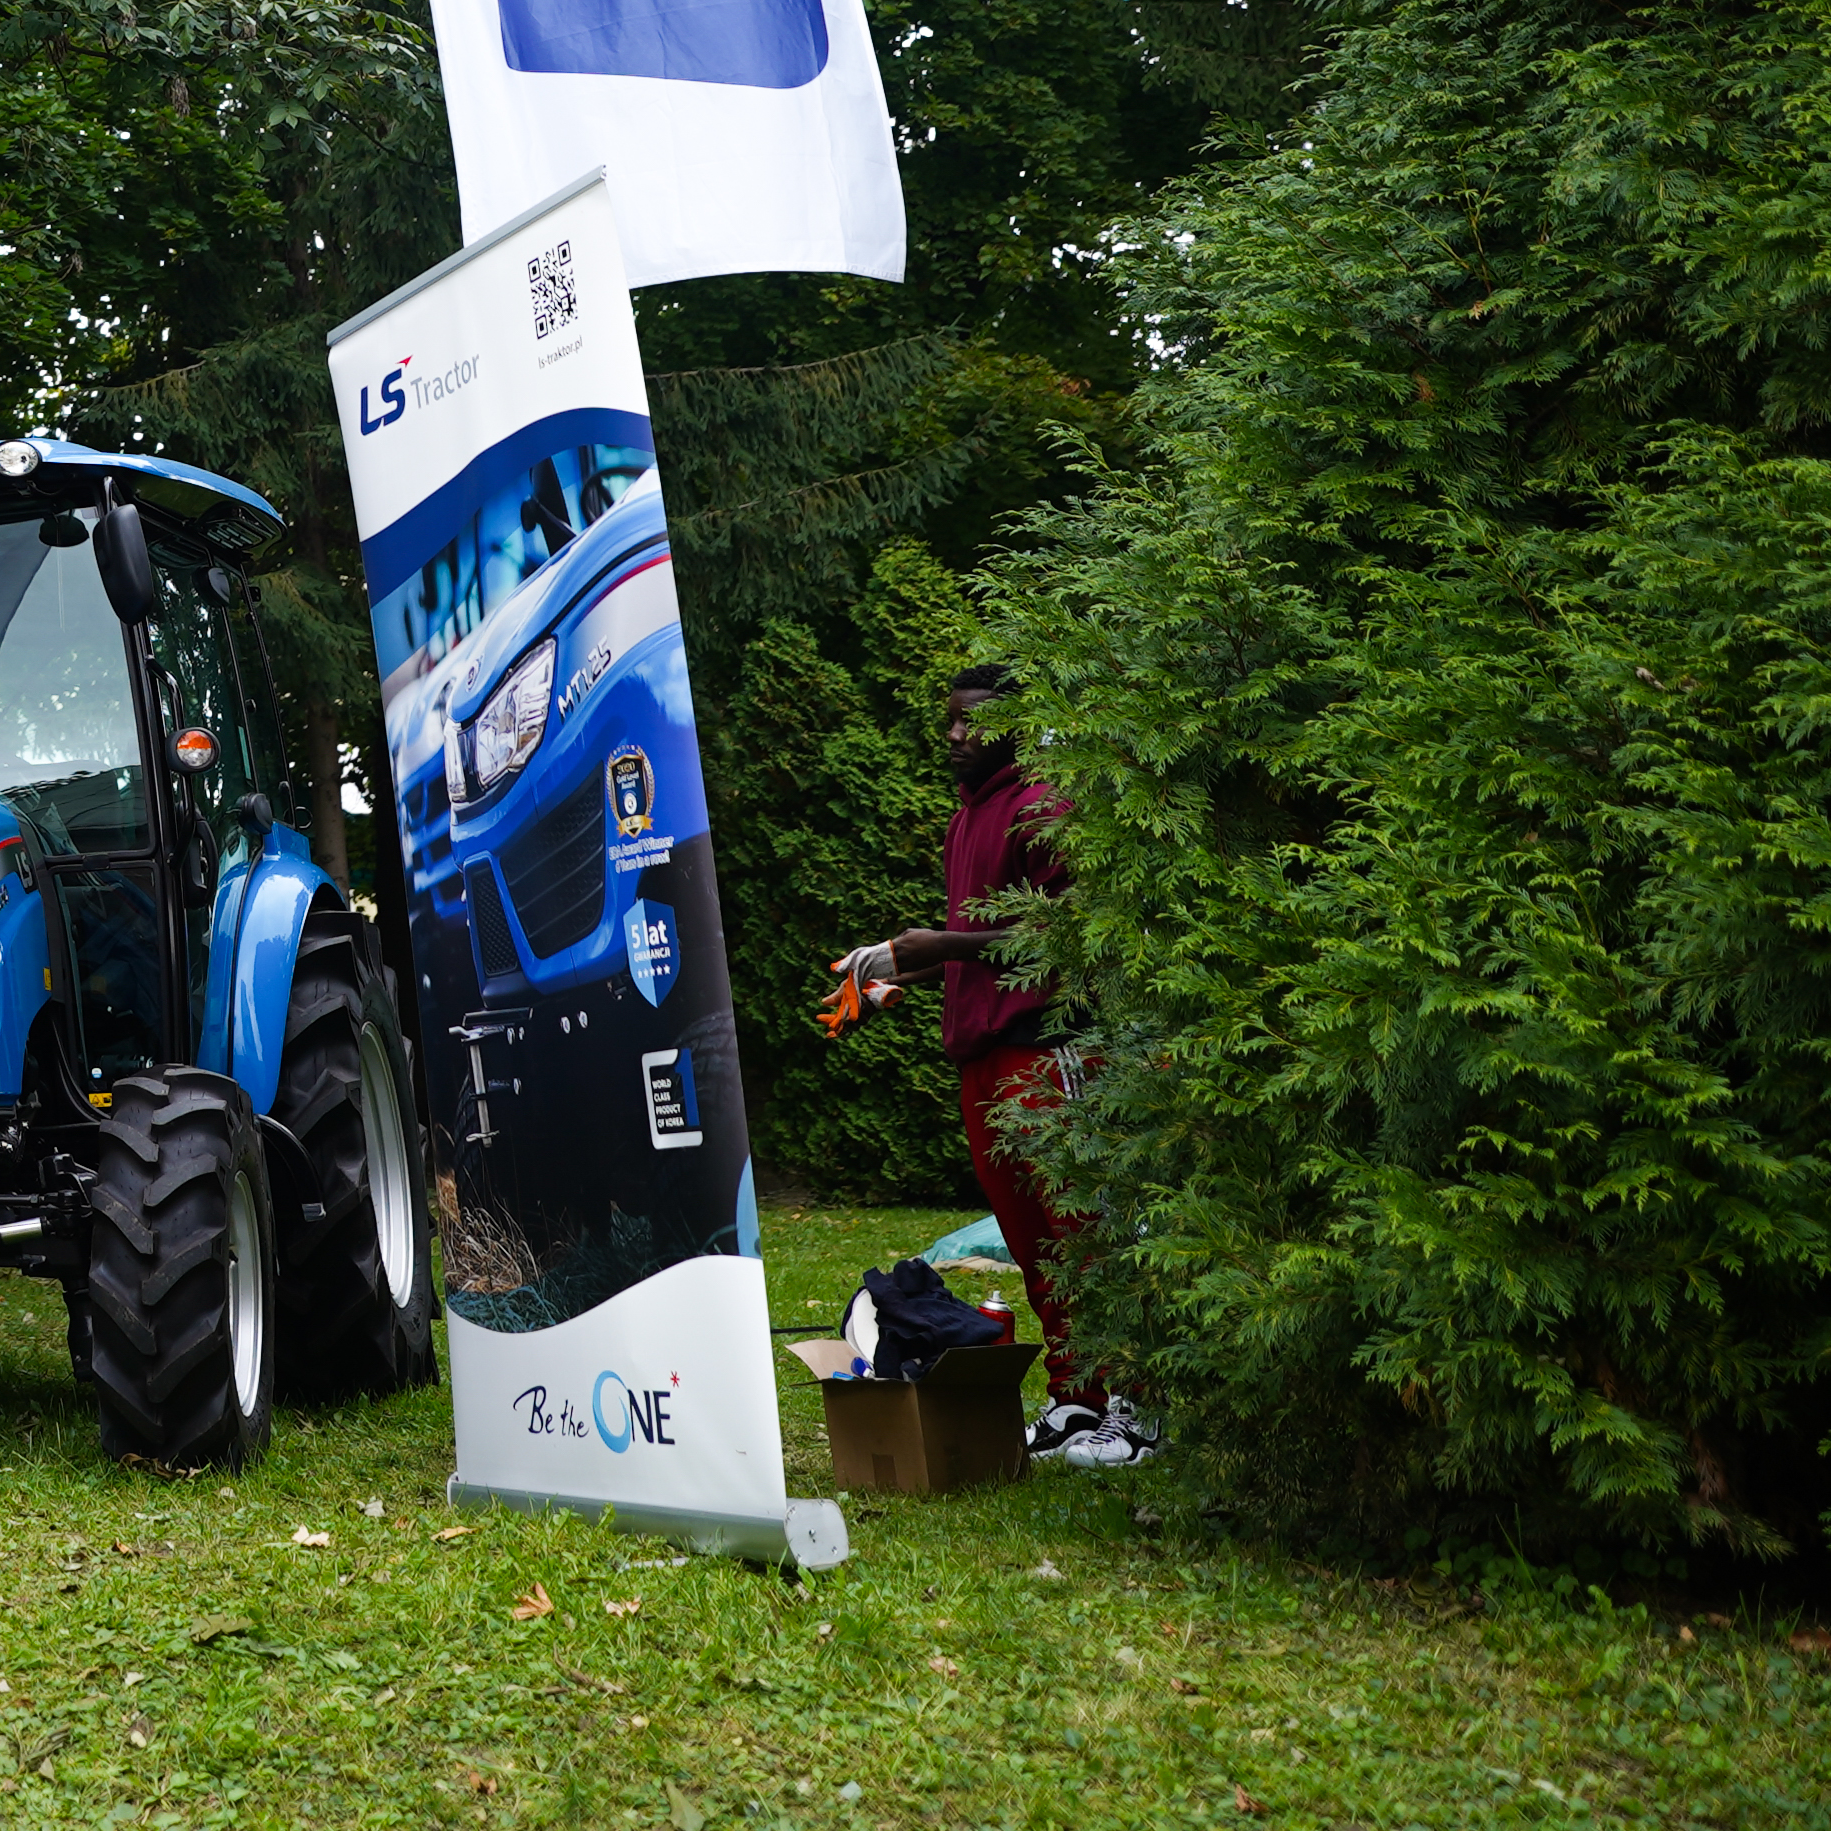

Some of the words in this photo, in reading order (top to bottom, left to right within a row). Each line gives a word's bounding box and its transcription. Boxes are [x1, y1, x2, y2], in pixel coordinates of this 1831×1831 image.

[538, 335, 584, 369] ls-traktor.pl
[360, 367, 406, 436] LS
[410, 354, 480, 409] Tractor
[15, 851, 34, 888] LS
[631, 924, 641, 949] 5
[642, 919, 669, 947] lat
[652, 1078, 672, 1089] WORLD
[653, 1091, 672, 1102] CLASS
[655, 1103, 681, 1115] PRODUCT
[657, 1118, 665, 1128] OF
[665, 1116, 685, 1127] KOREA
[512, 1385, 555, 1434] Be
[560, 1399, 590, 1438] the
[592, 1370, 676, 1454] ONE
